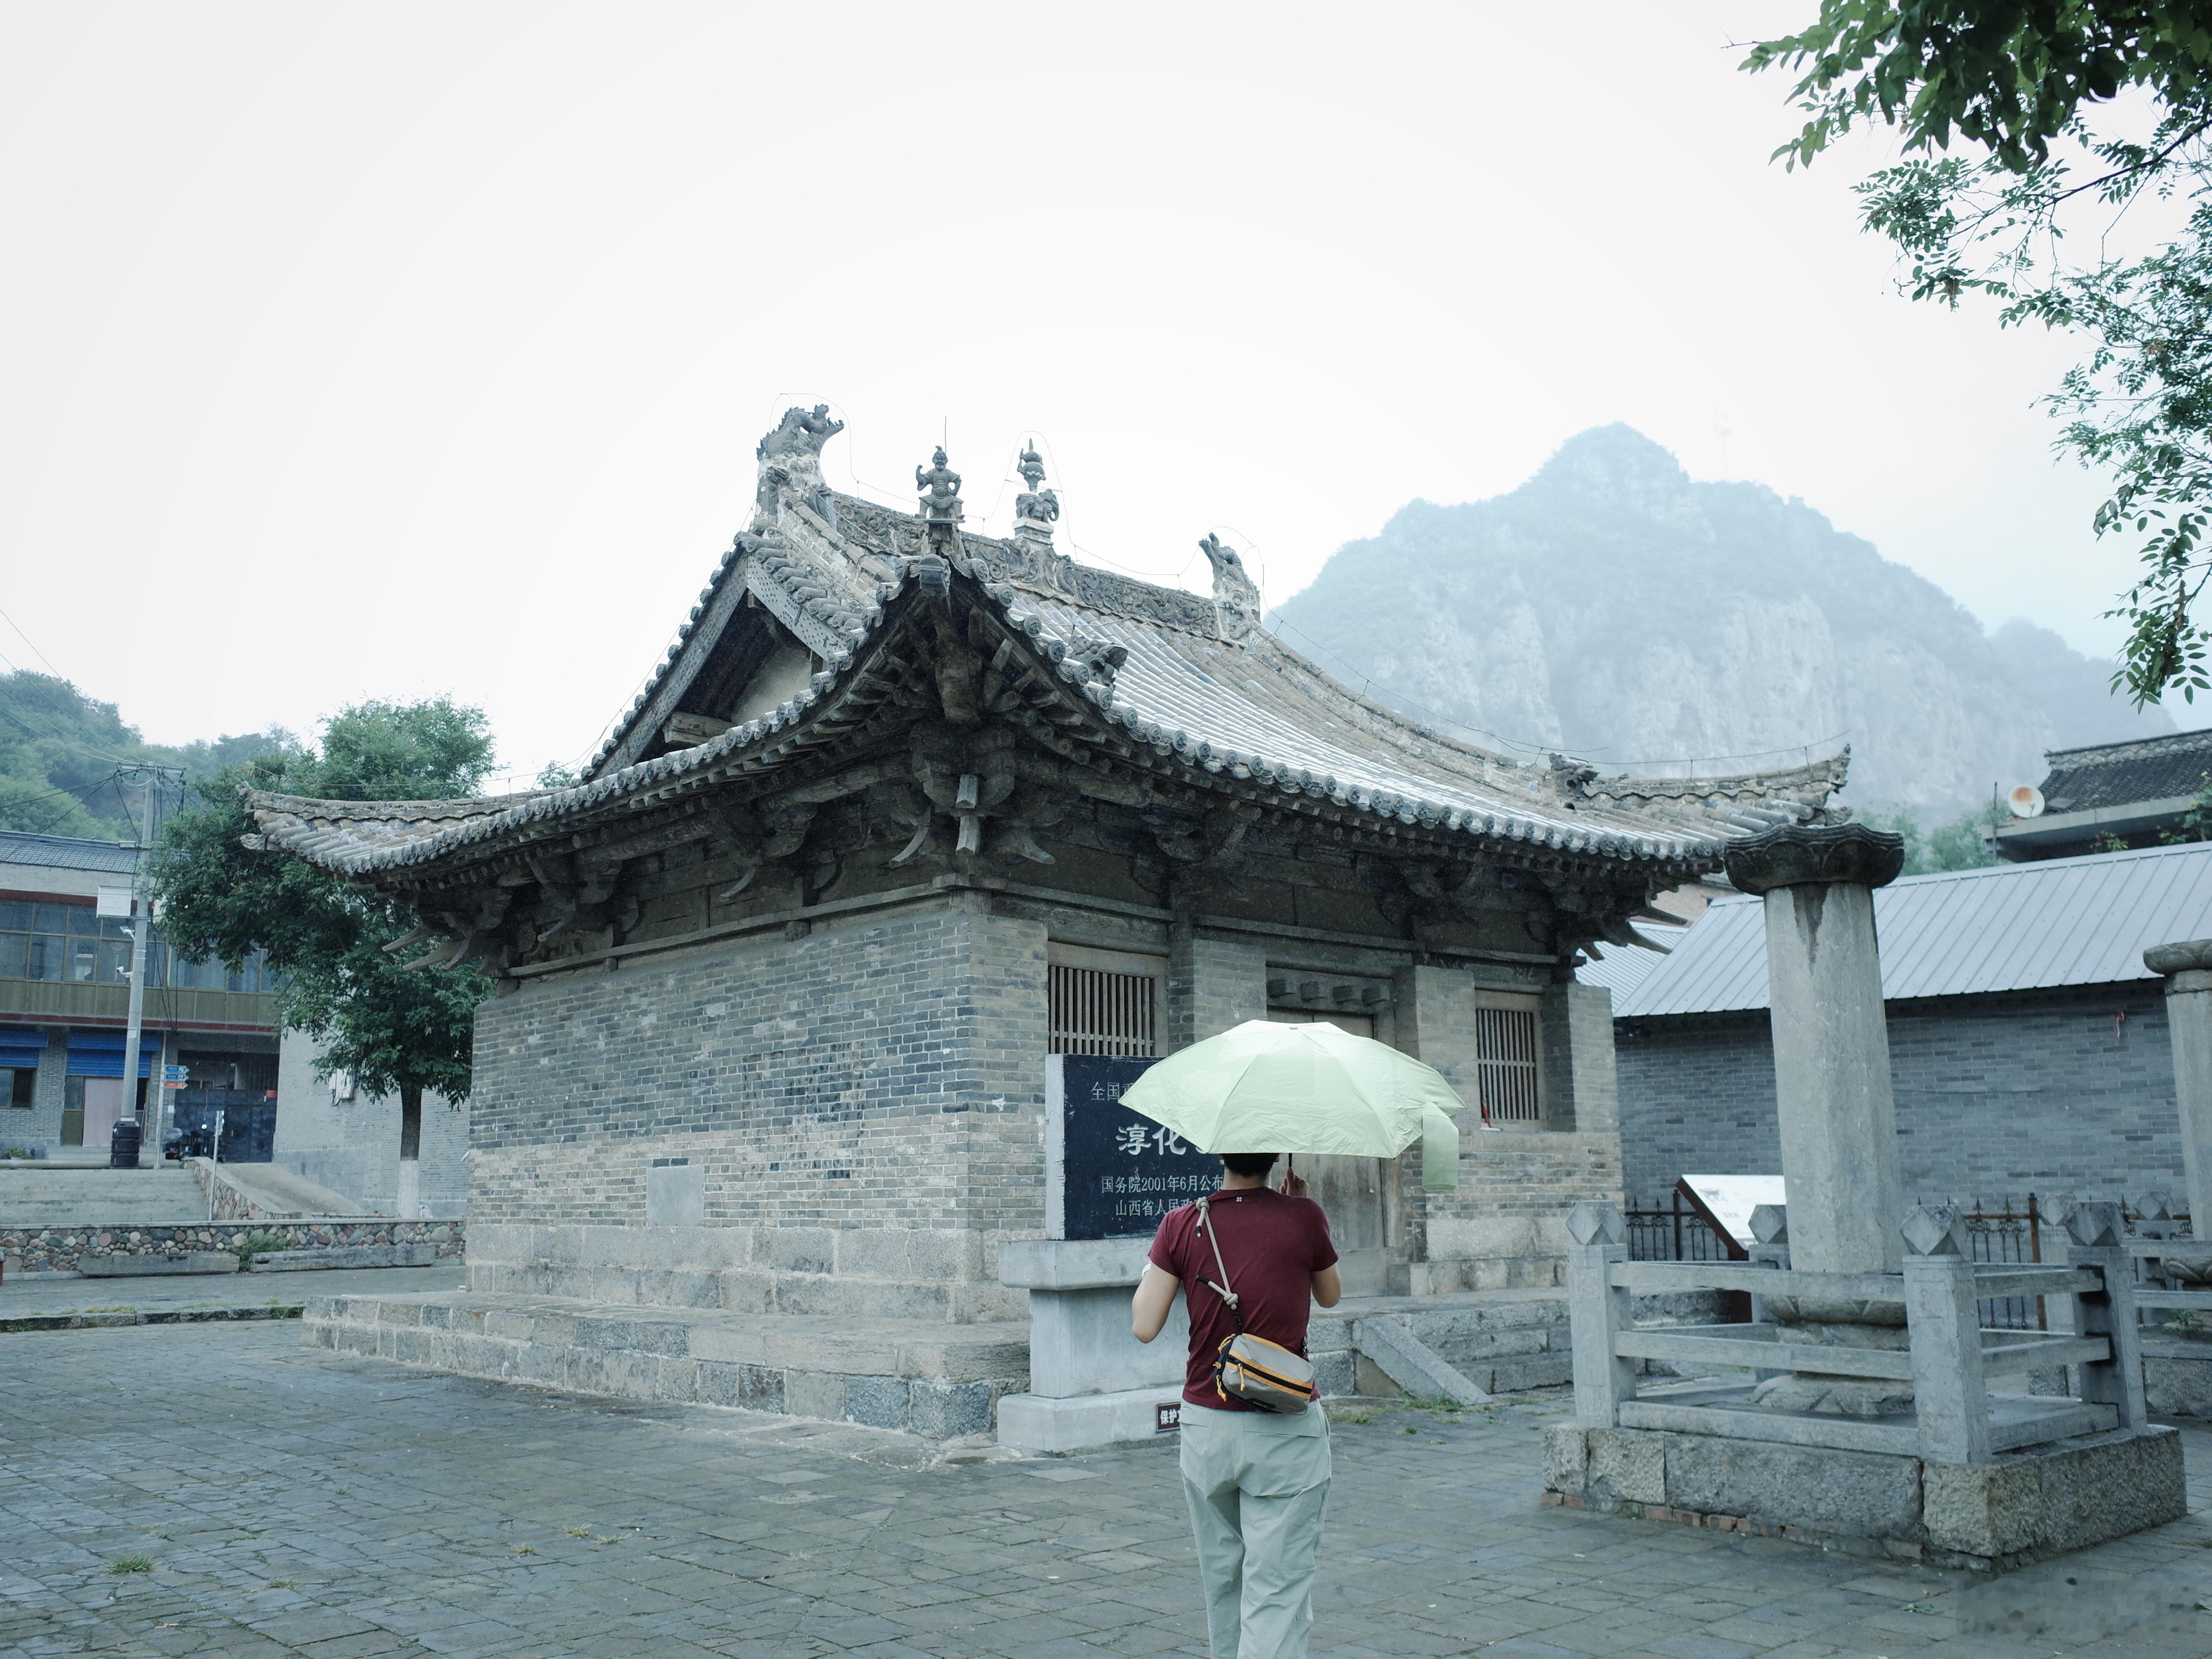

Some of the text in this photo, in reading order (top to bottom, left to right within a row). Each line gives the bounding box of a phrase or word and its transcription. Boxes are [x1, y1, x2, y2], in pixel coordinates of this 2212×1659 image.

[1116, 1123, 1206, 1155] 淳化
[1101, 1174, 1223, 1194] 国务院2001年6月公布
[1116, 1197, 1197, 1216] 山西省人民
[1160, 1408, 1180, 1425] 保护
